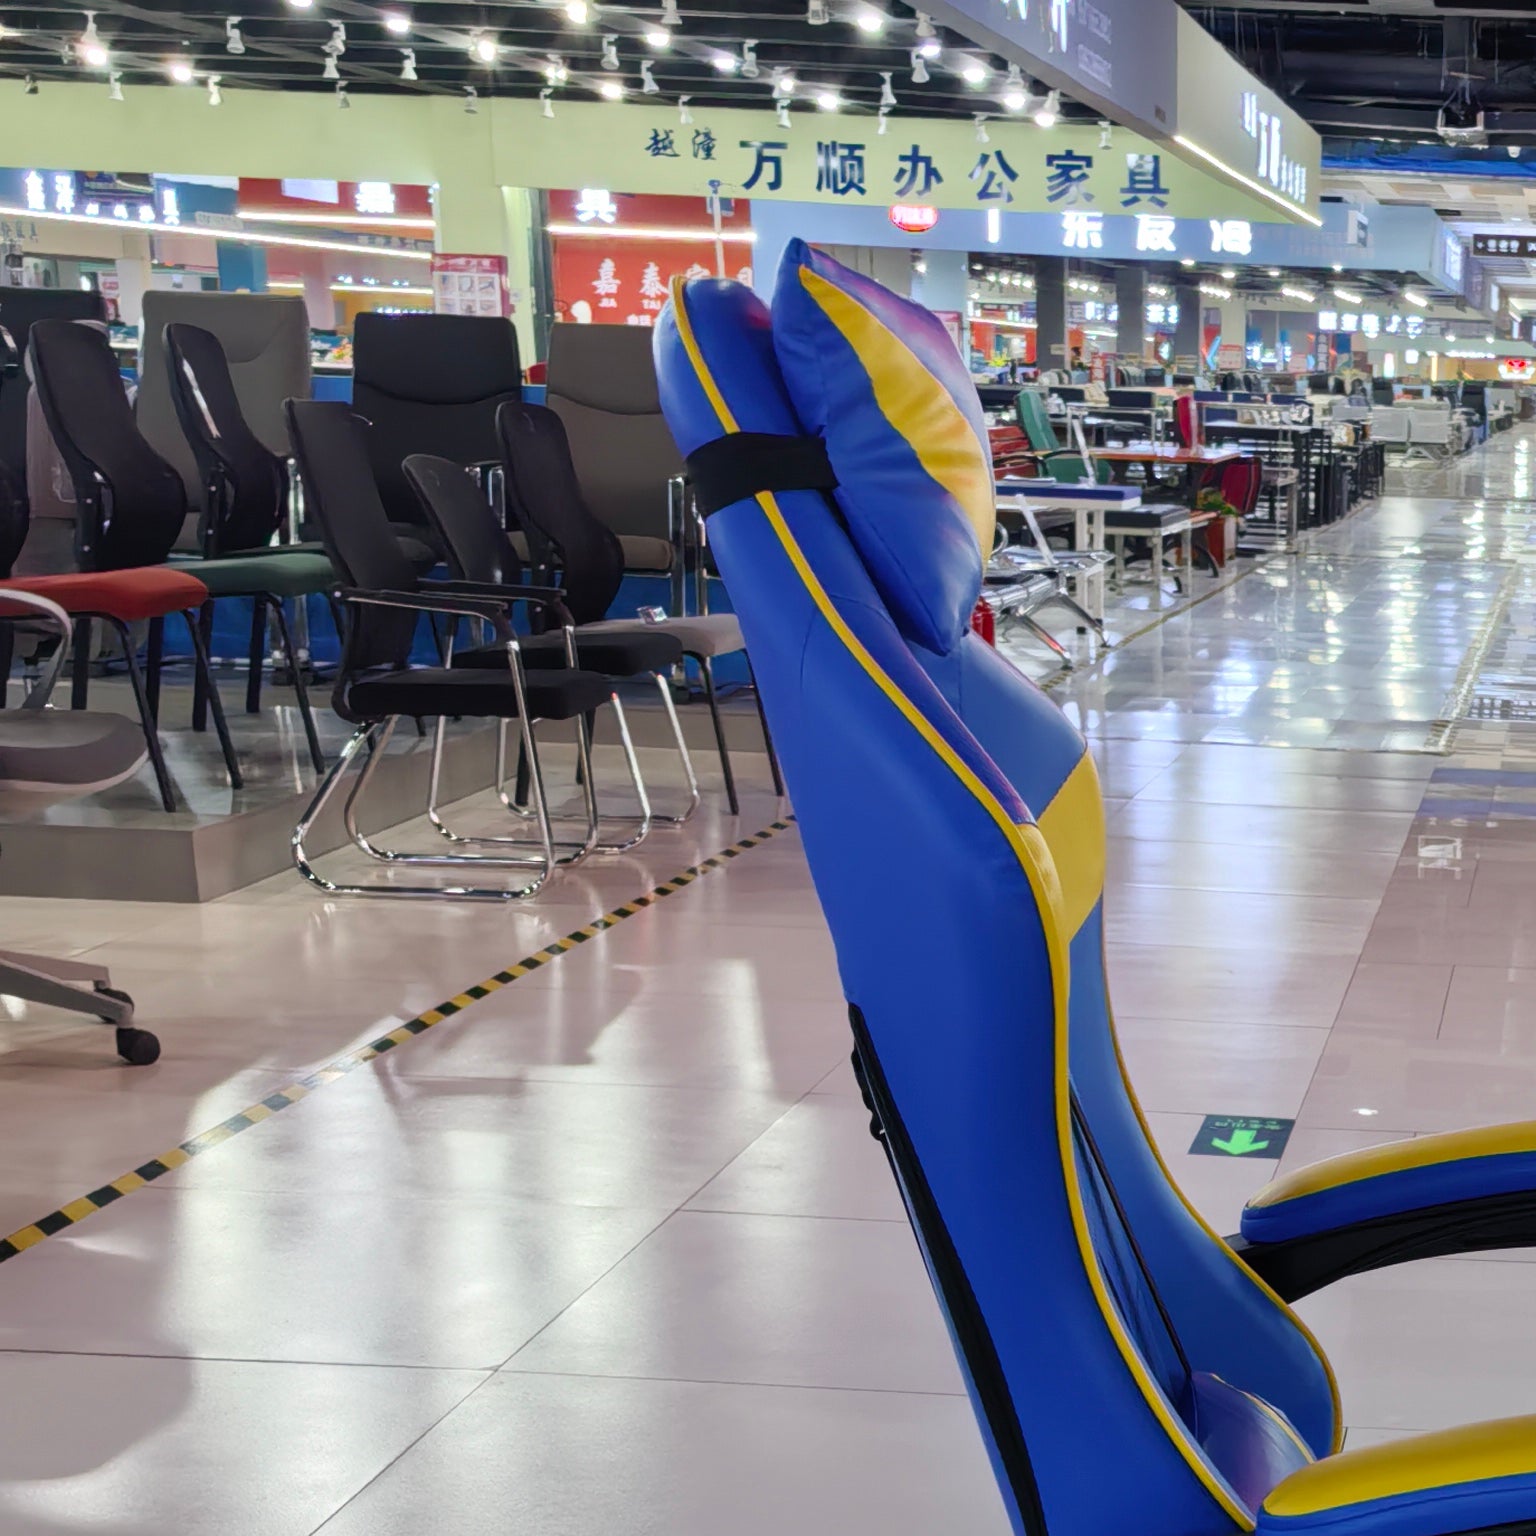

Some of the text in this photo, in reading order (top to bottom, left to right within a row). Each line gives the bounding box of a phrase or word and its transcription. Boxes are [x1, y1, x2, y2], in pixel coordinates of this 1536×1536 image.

[739, 139, 1170, 209] 万顺办公家具
